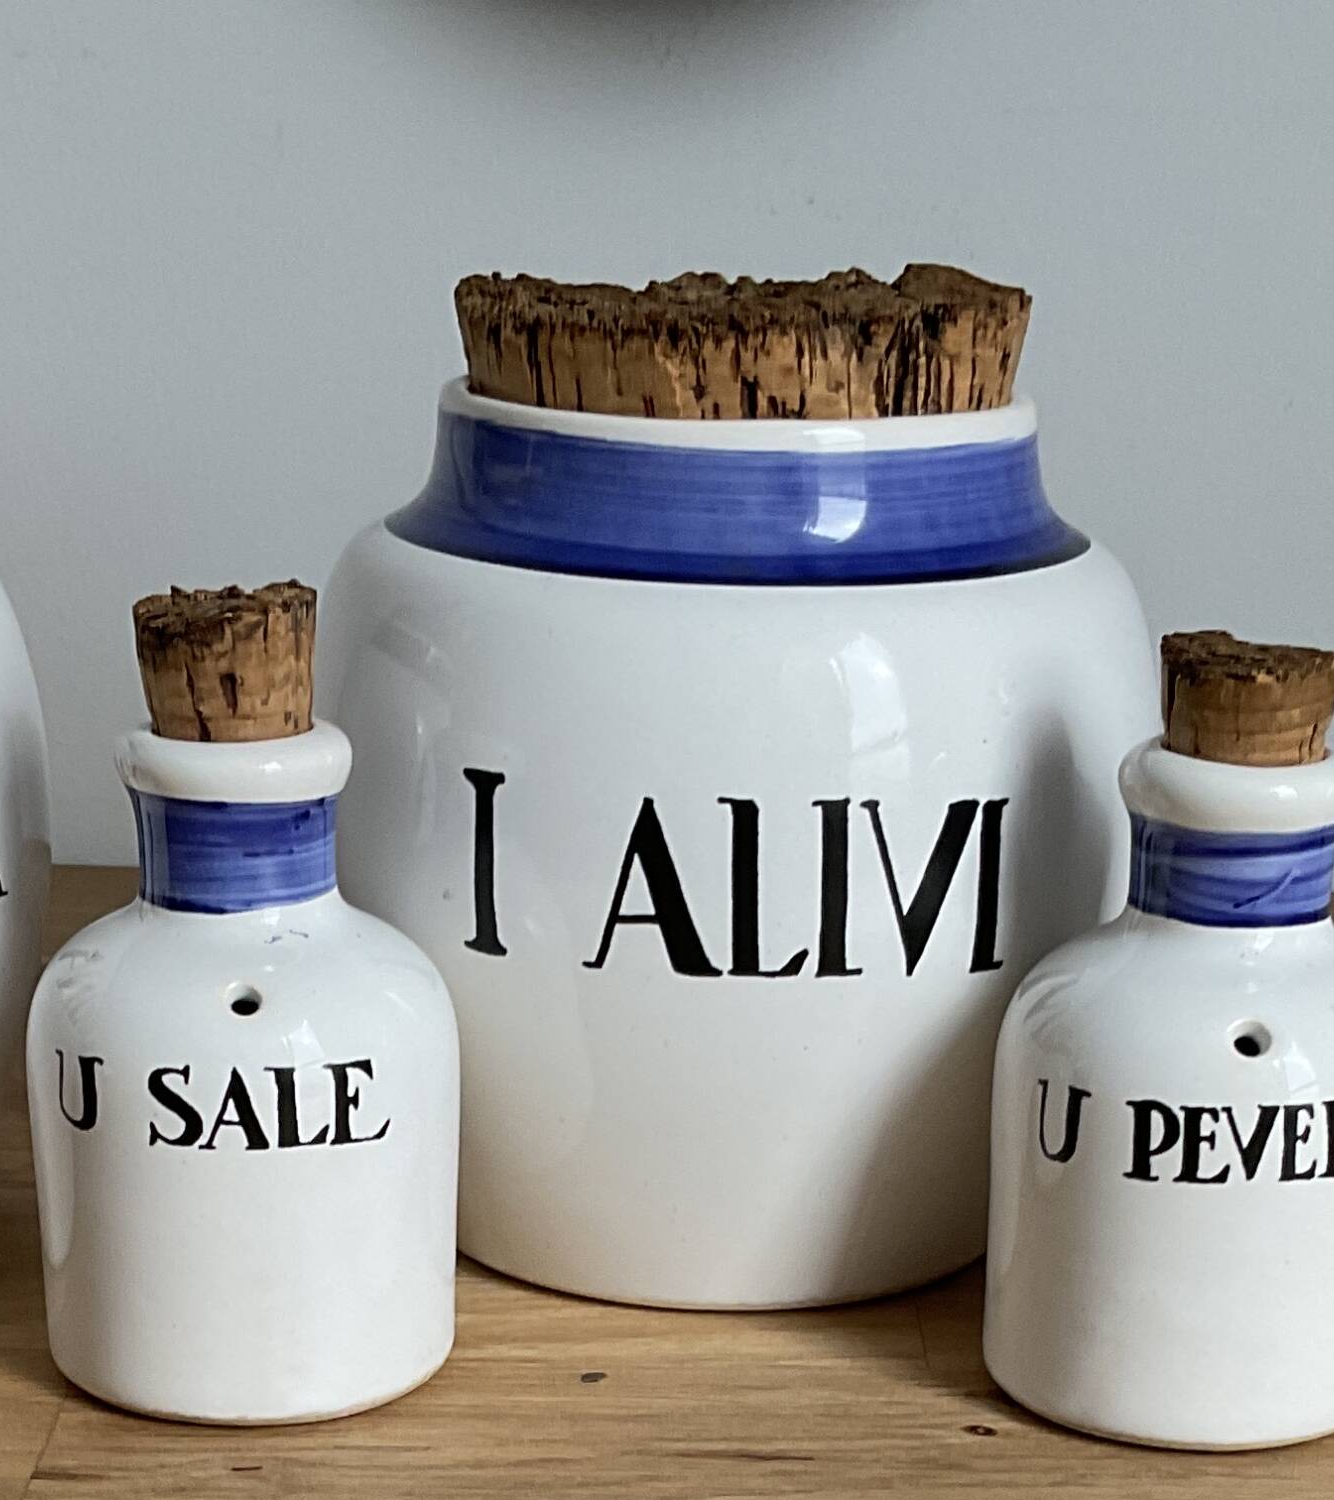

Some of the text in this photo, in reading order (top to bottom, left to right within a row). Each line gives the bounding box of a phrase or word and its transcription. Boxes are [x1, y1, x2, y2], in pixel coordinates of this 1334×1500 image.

[461, 766, 1011, 979] I ALIVI
[54, 1047, 391, 1152] U SALE
[1036, 1077, 1094, 1165] U
